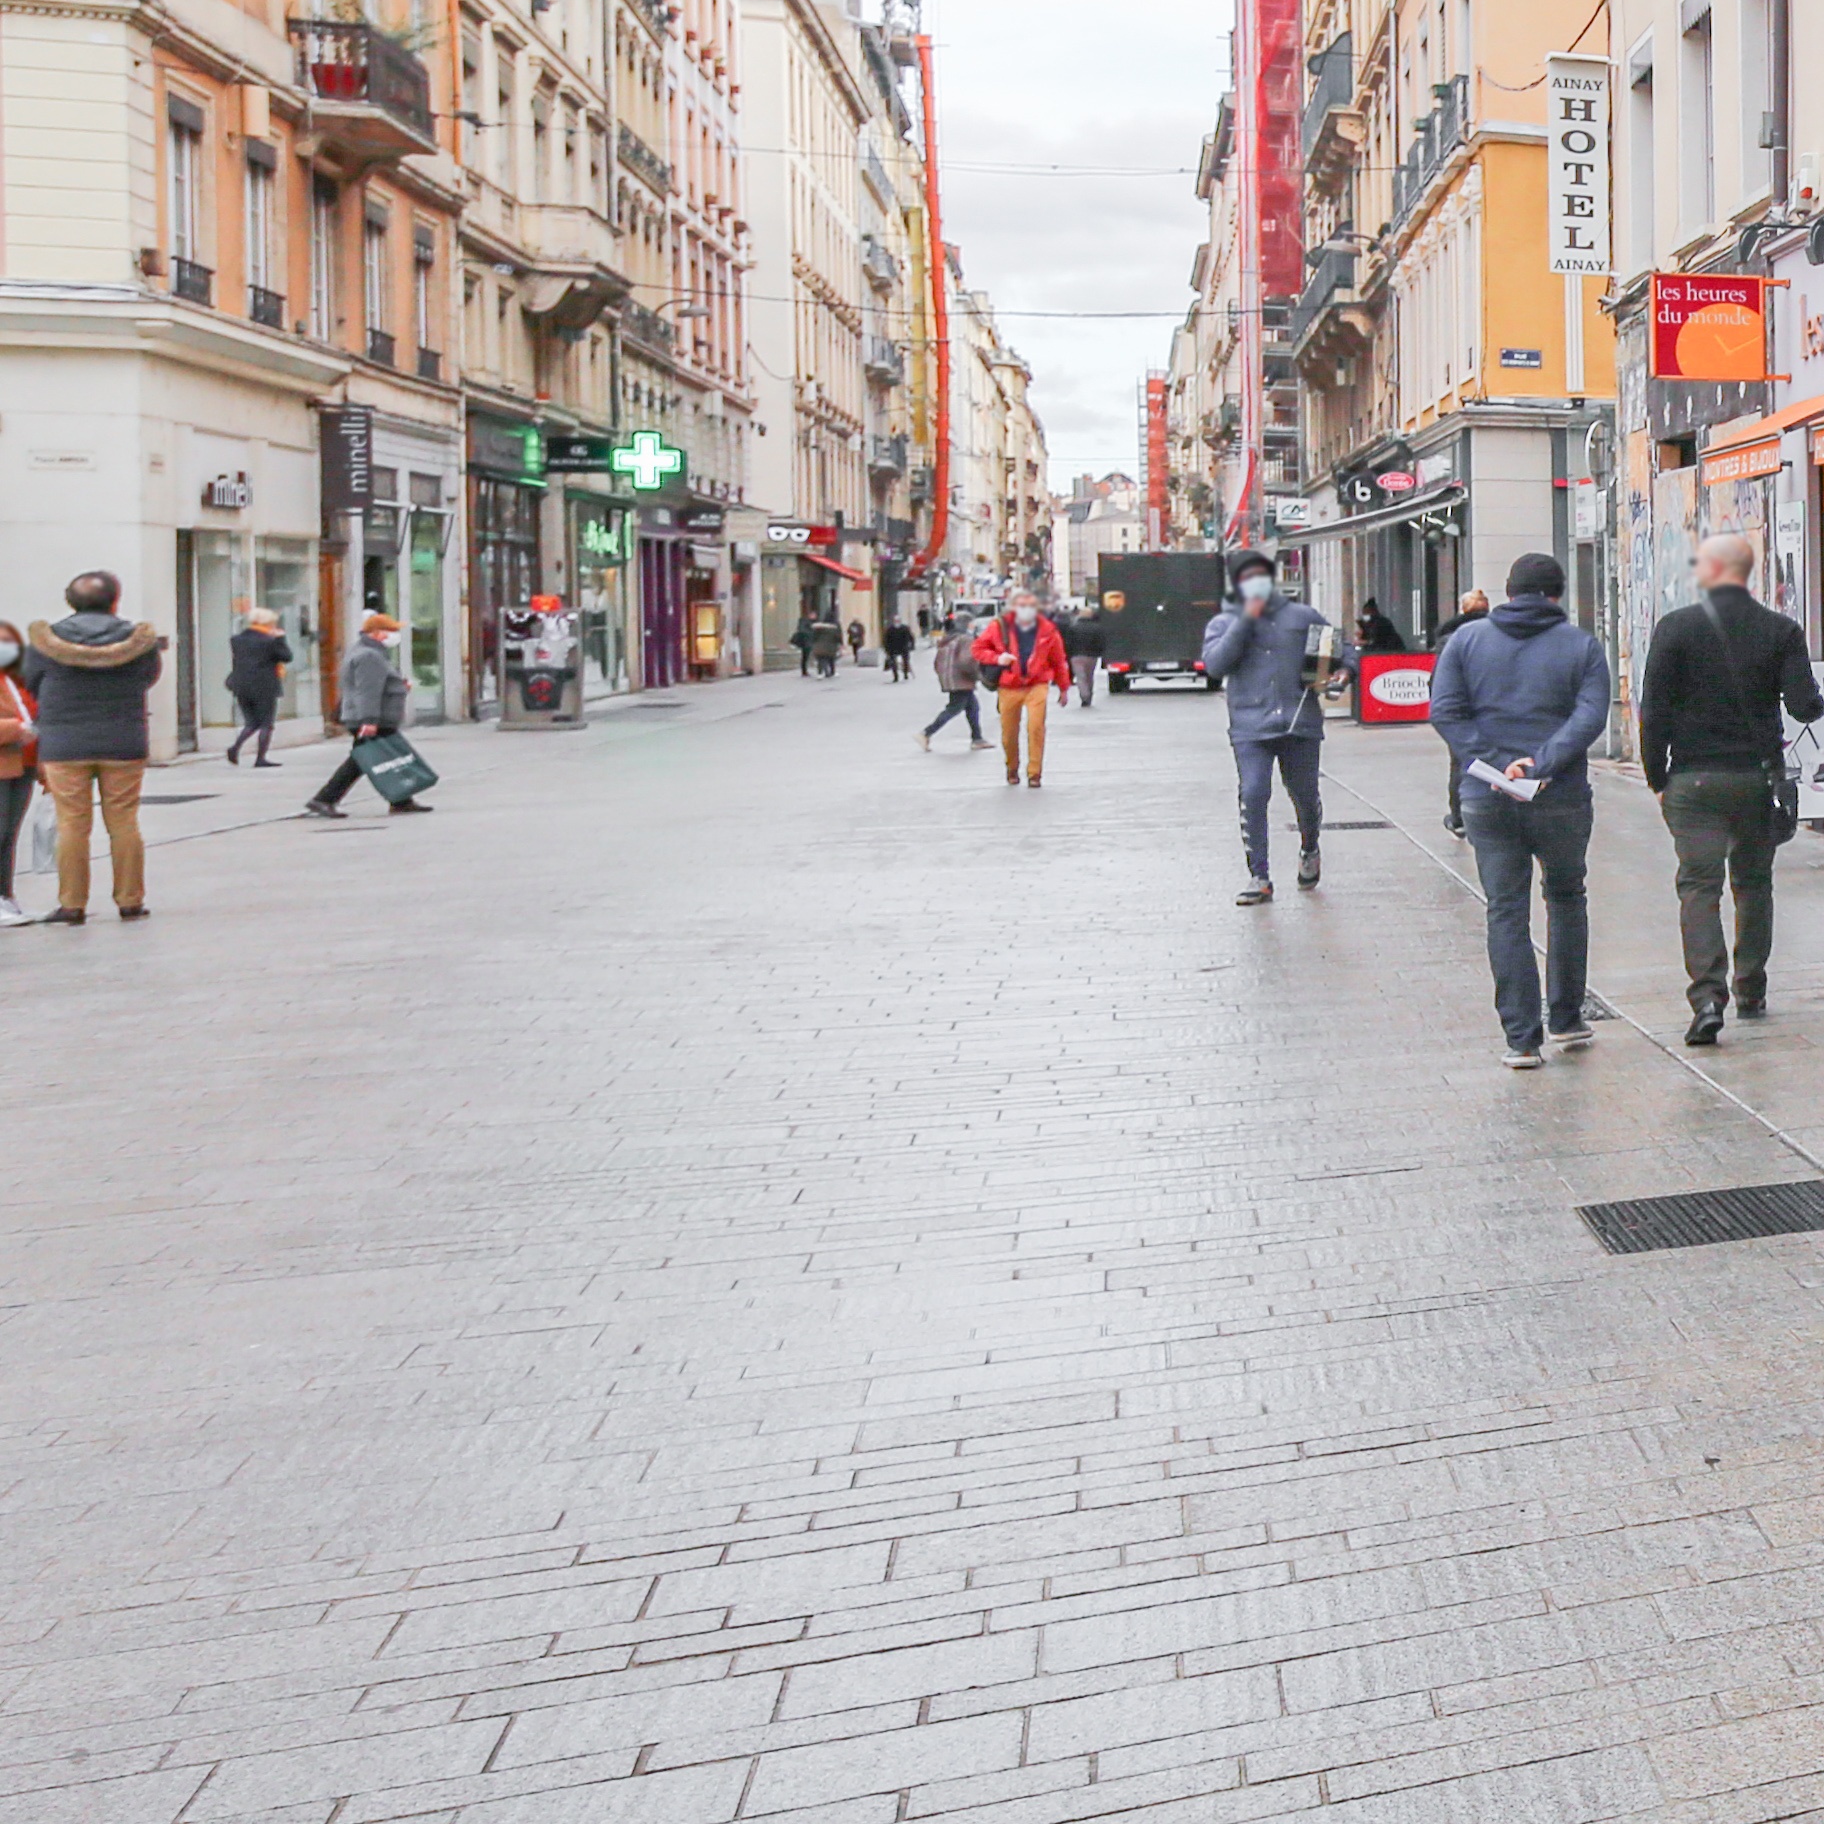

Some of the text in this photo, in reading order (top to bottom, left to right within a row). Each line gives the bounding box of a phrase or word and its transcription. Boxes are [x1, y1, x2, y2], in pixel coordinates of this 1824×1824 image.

[1551, 76, 1604, 92] AINAY
[1559, 96, 1598, 250] HOTEL
[1554, 258, 1606, 272] AINAY
[1656, 279, 1747, 303] les heures
[1657, 304, 1751, 326] du monde
[340, 415, 368, 493] minelli
[1383, 674, 1429, 689] Brioch
